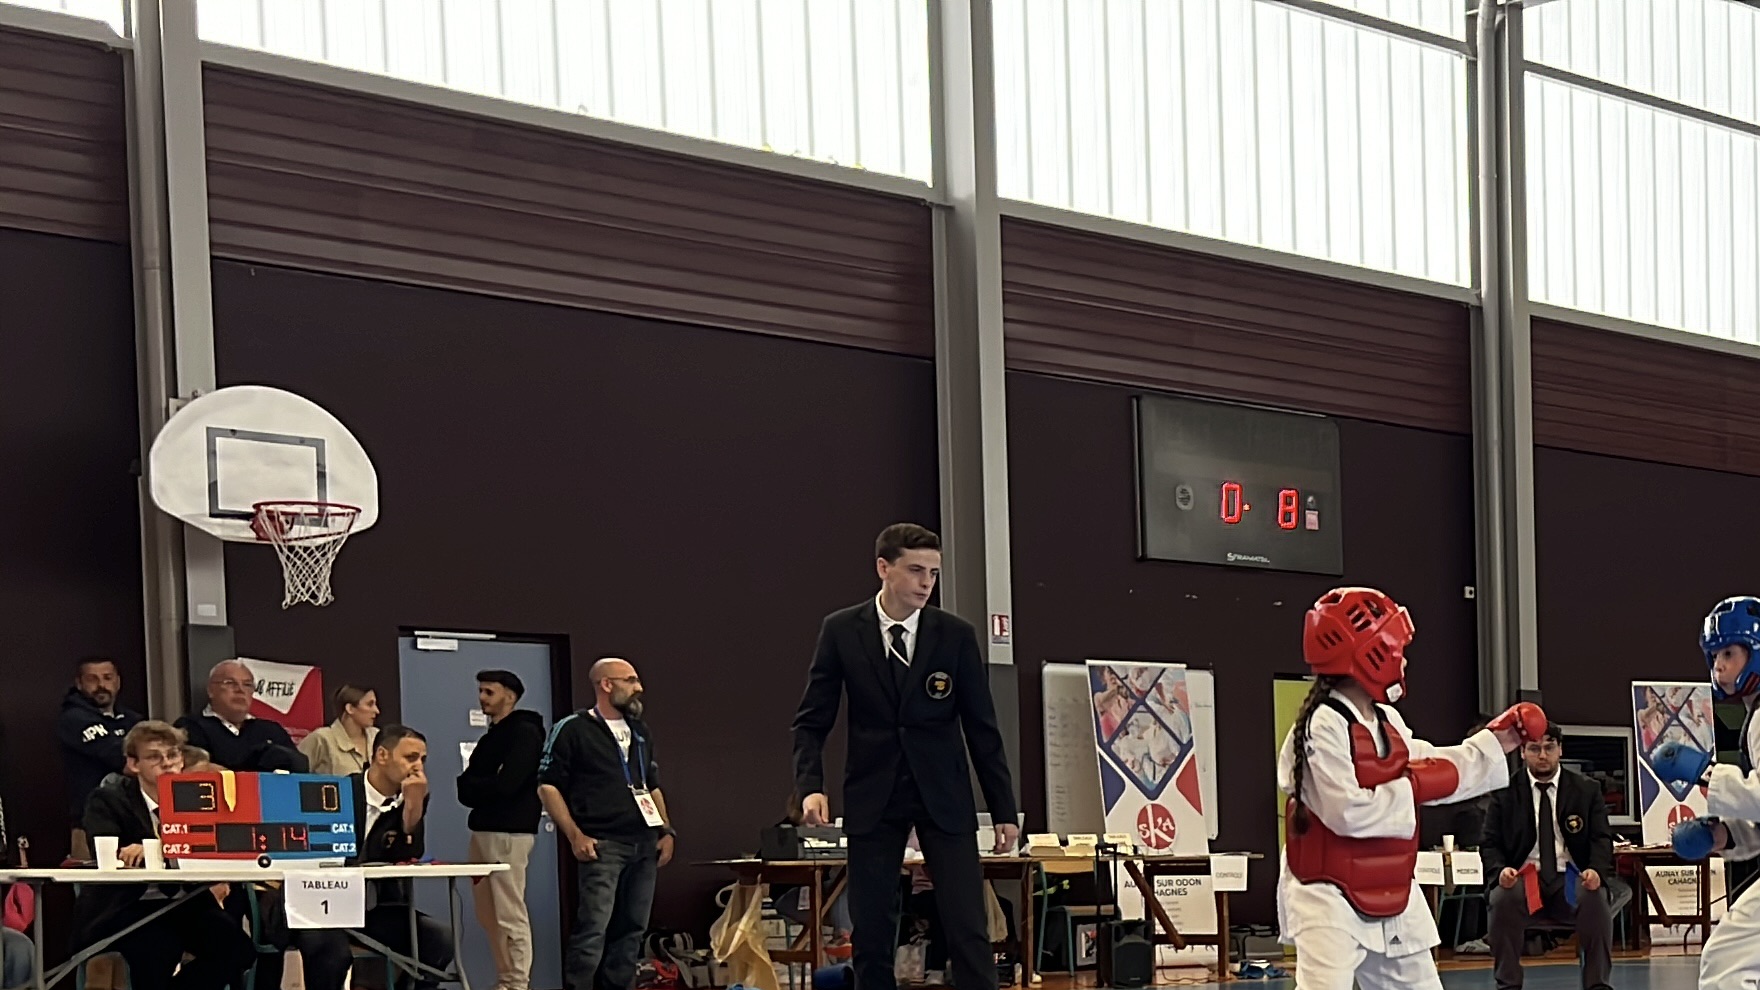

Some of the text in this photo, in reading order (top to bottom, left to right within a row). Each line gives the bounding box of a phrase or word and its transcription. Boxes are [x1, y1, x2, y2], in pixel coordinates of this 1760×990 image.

[199, 782, 216, 811] 3
[321, 784, 338, 811] 0
[162, 823, 188, 835] CAT.1
[331, 823, 355, 834] CAT.1
[163, 843, 191, 854] CAT.2
[332, 843, 357, 853] CAT.2
[302, 880, 349, 890] TABLEAU
[1156, 878, 1202, 888] SUR ODON
[1667, 877, 1697, 886] CAHAGN
[1155, 887, 1188, 897] HAGNES
[320, 899, 329, 915] 1
